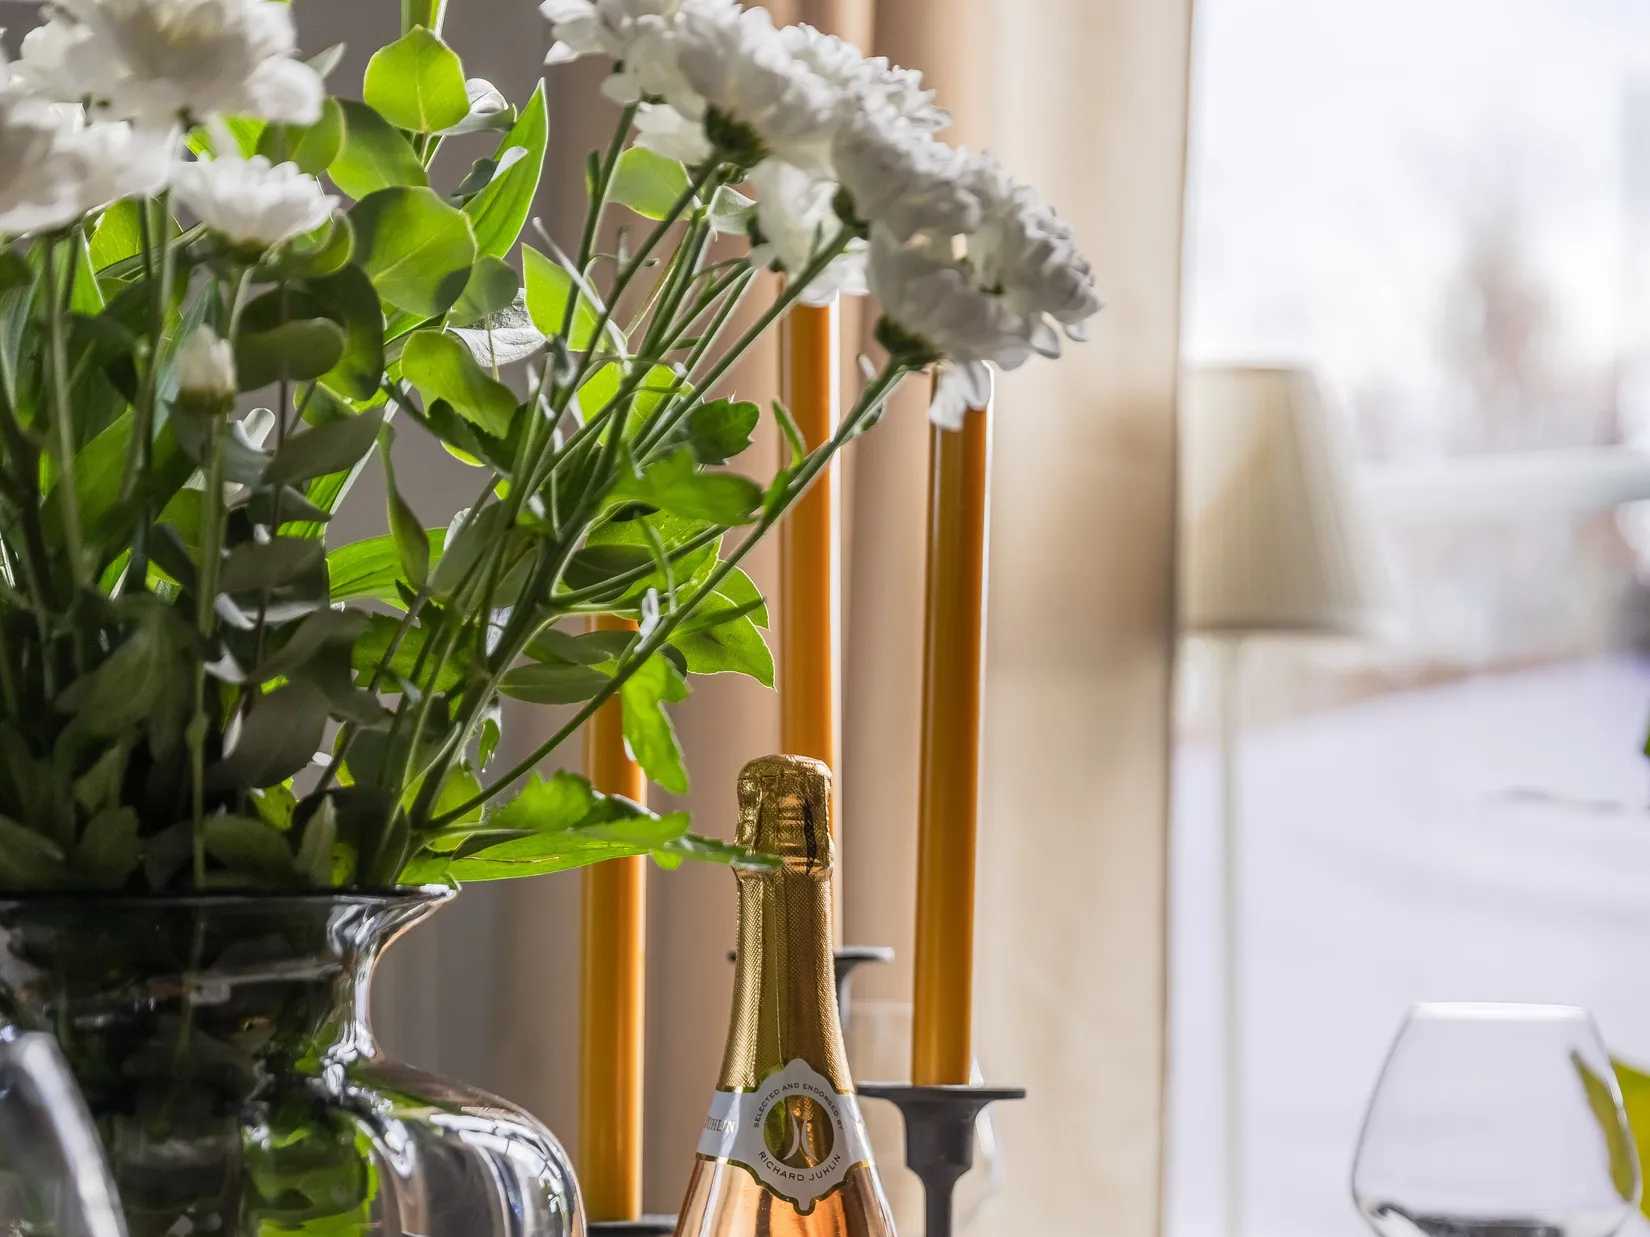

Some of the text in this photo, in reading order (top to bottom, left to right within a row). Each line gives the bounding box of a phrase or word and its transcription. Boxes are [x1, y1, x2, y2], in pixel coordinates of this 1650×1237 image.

[753, 1088, 780, 1128] SELECTED
[782, 1082, 800, 1091] AND
[802, 1083, 839, 1117] ENDORSED
[758, 1151, 842, 1182] RICHARD JUHLIN
